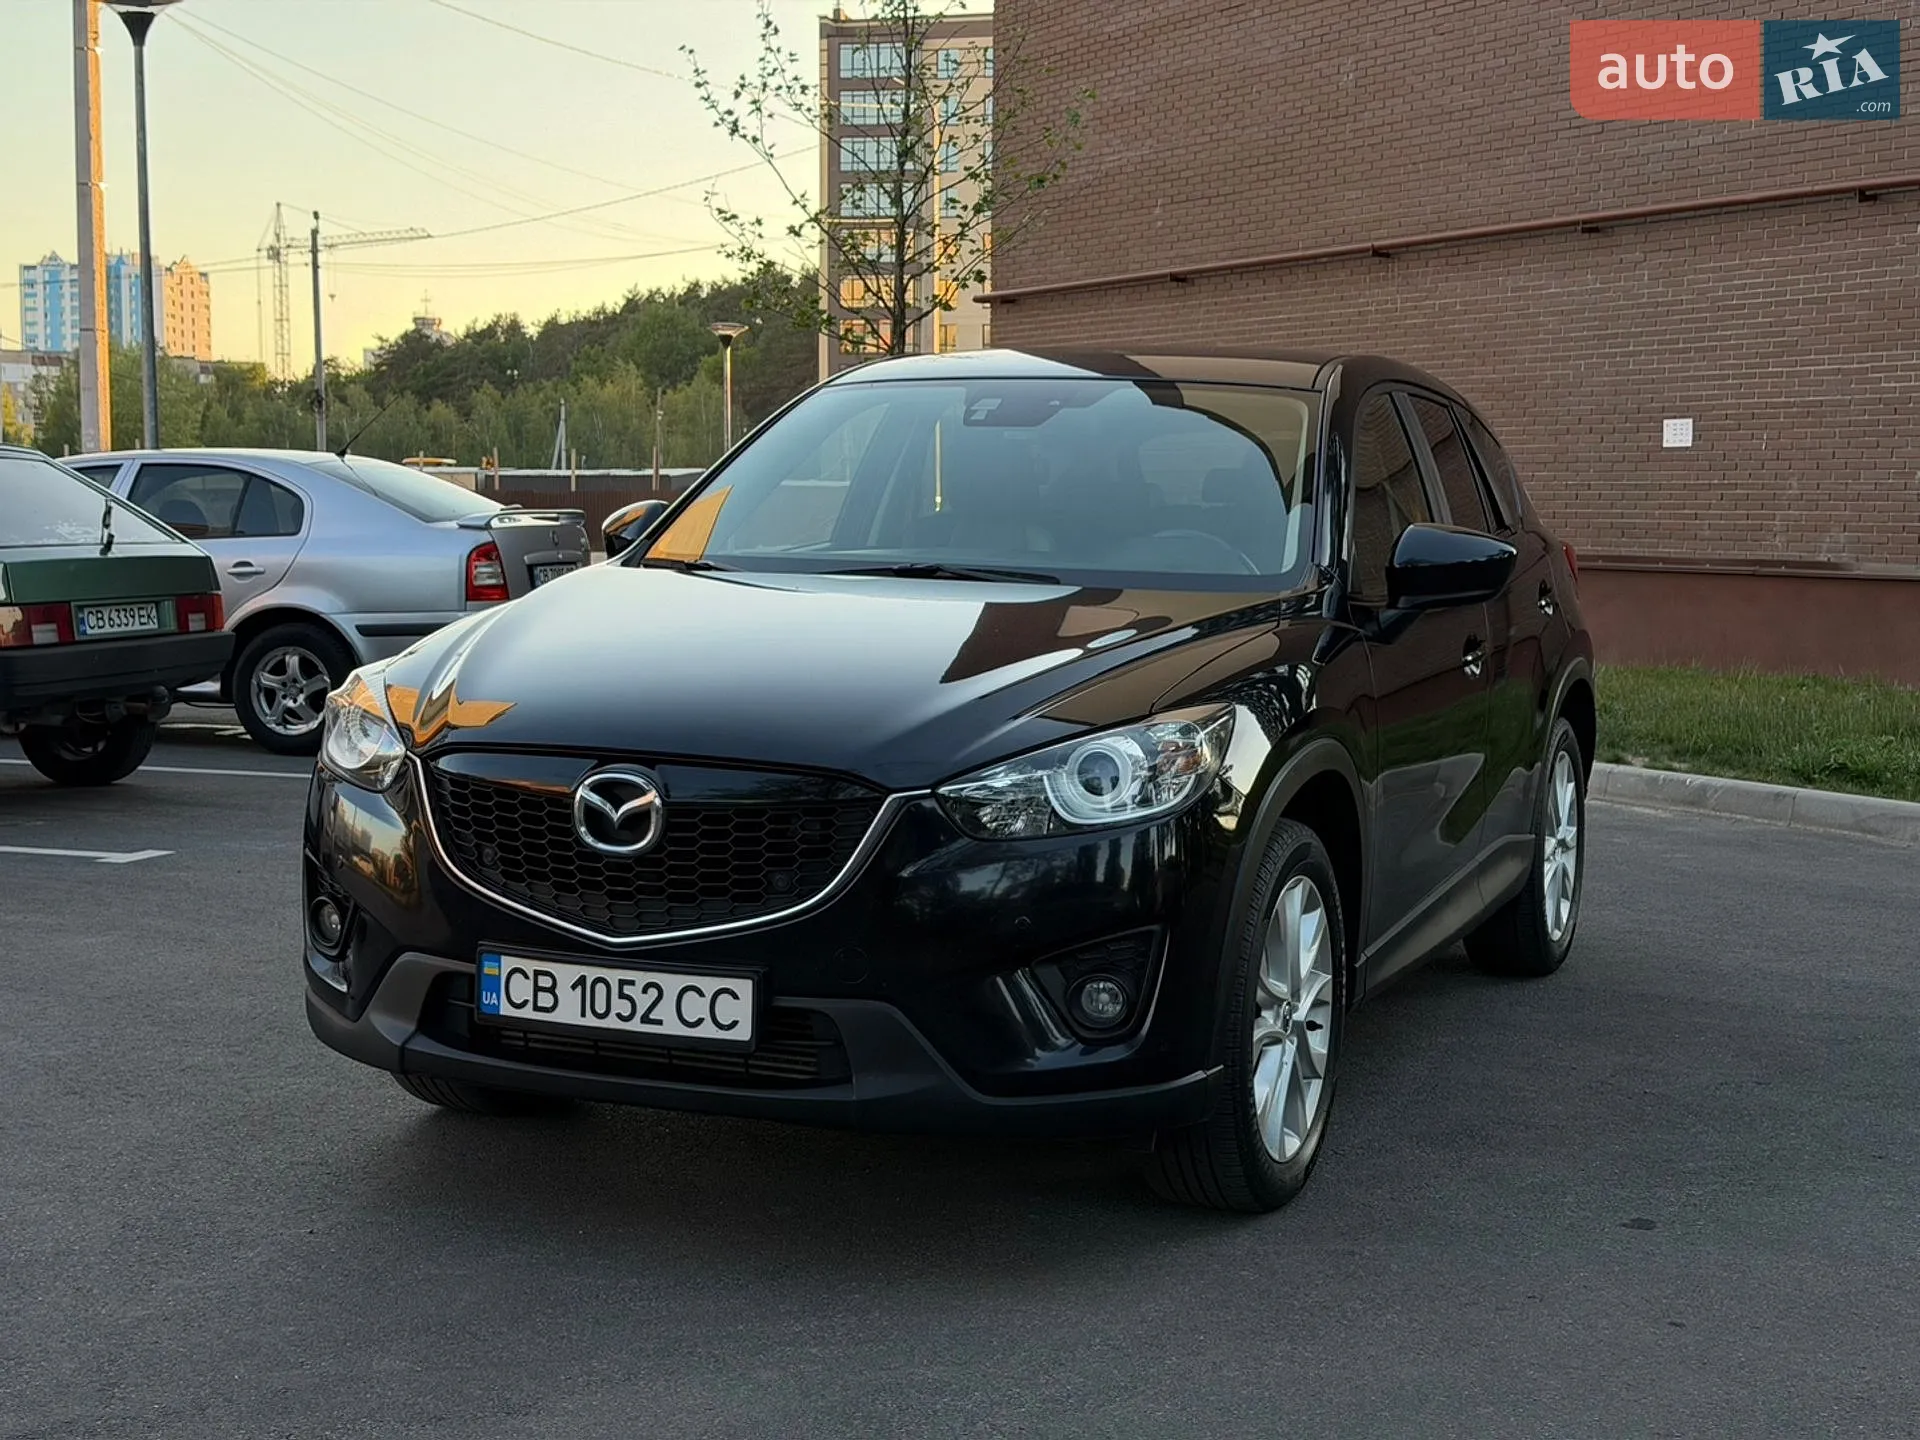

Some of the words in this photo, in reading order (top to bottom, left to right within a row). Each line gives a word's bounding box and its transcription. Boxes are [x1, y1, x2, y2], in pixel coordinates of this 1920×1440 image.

[86, 610, 106, 630] CB
[108, 607, 136, 628] 6339
[138, 606, 156, 626] EK
[482, 991, 499, 1006] UA
[504, 966, 560, 1014] CB
[569, 974, 664, 1027] 1052
[675, 984, 740, 1031] CC
